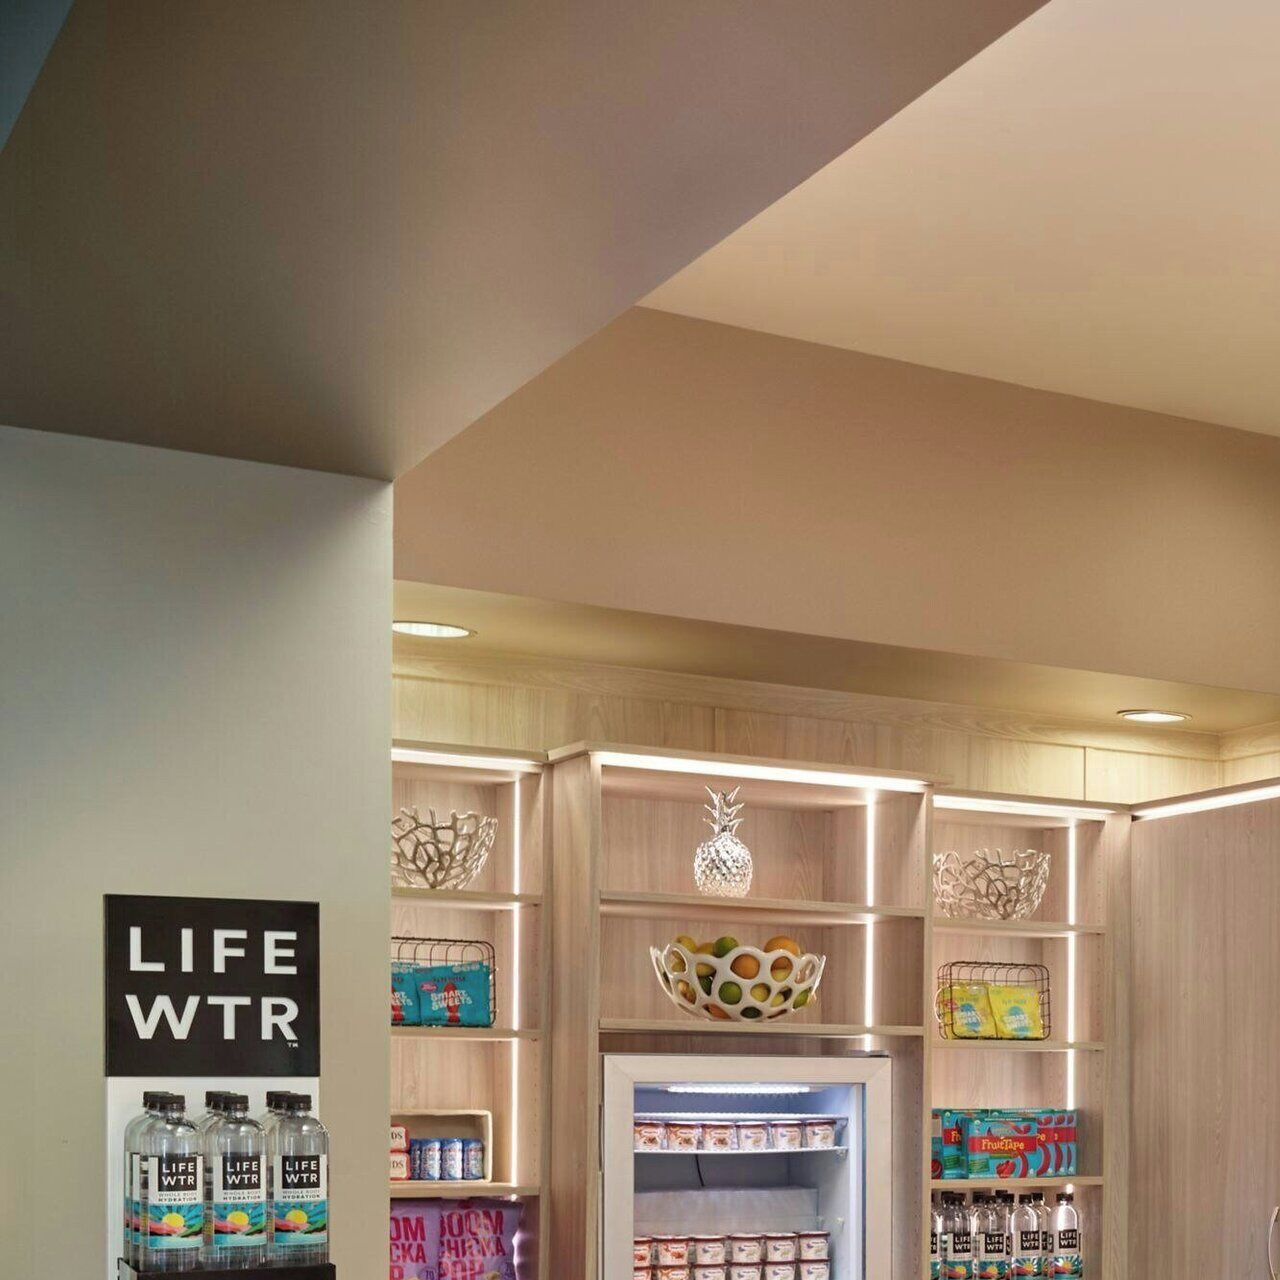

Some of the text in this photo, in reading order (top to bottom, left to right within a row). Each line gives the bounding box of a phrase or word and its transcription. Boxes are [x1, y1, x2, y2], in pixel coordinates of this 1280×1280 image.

[130, 926, 298, 975] LIFE
[125, 994, 299, 1041] WTR
[162, 1162, 195, 1173] LIFE
[227, 1161, 258, 1172] LIFE
[285, 1161, 317, 1171] LIFE
[162, 1175, 195, 1186] WTR
[227, 1174, 259, 1184] WTR
[285, 1173, 317, 1183] WTR
